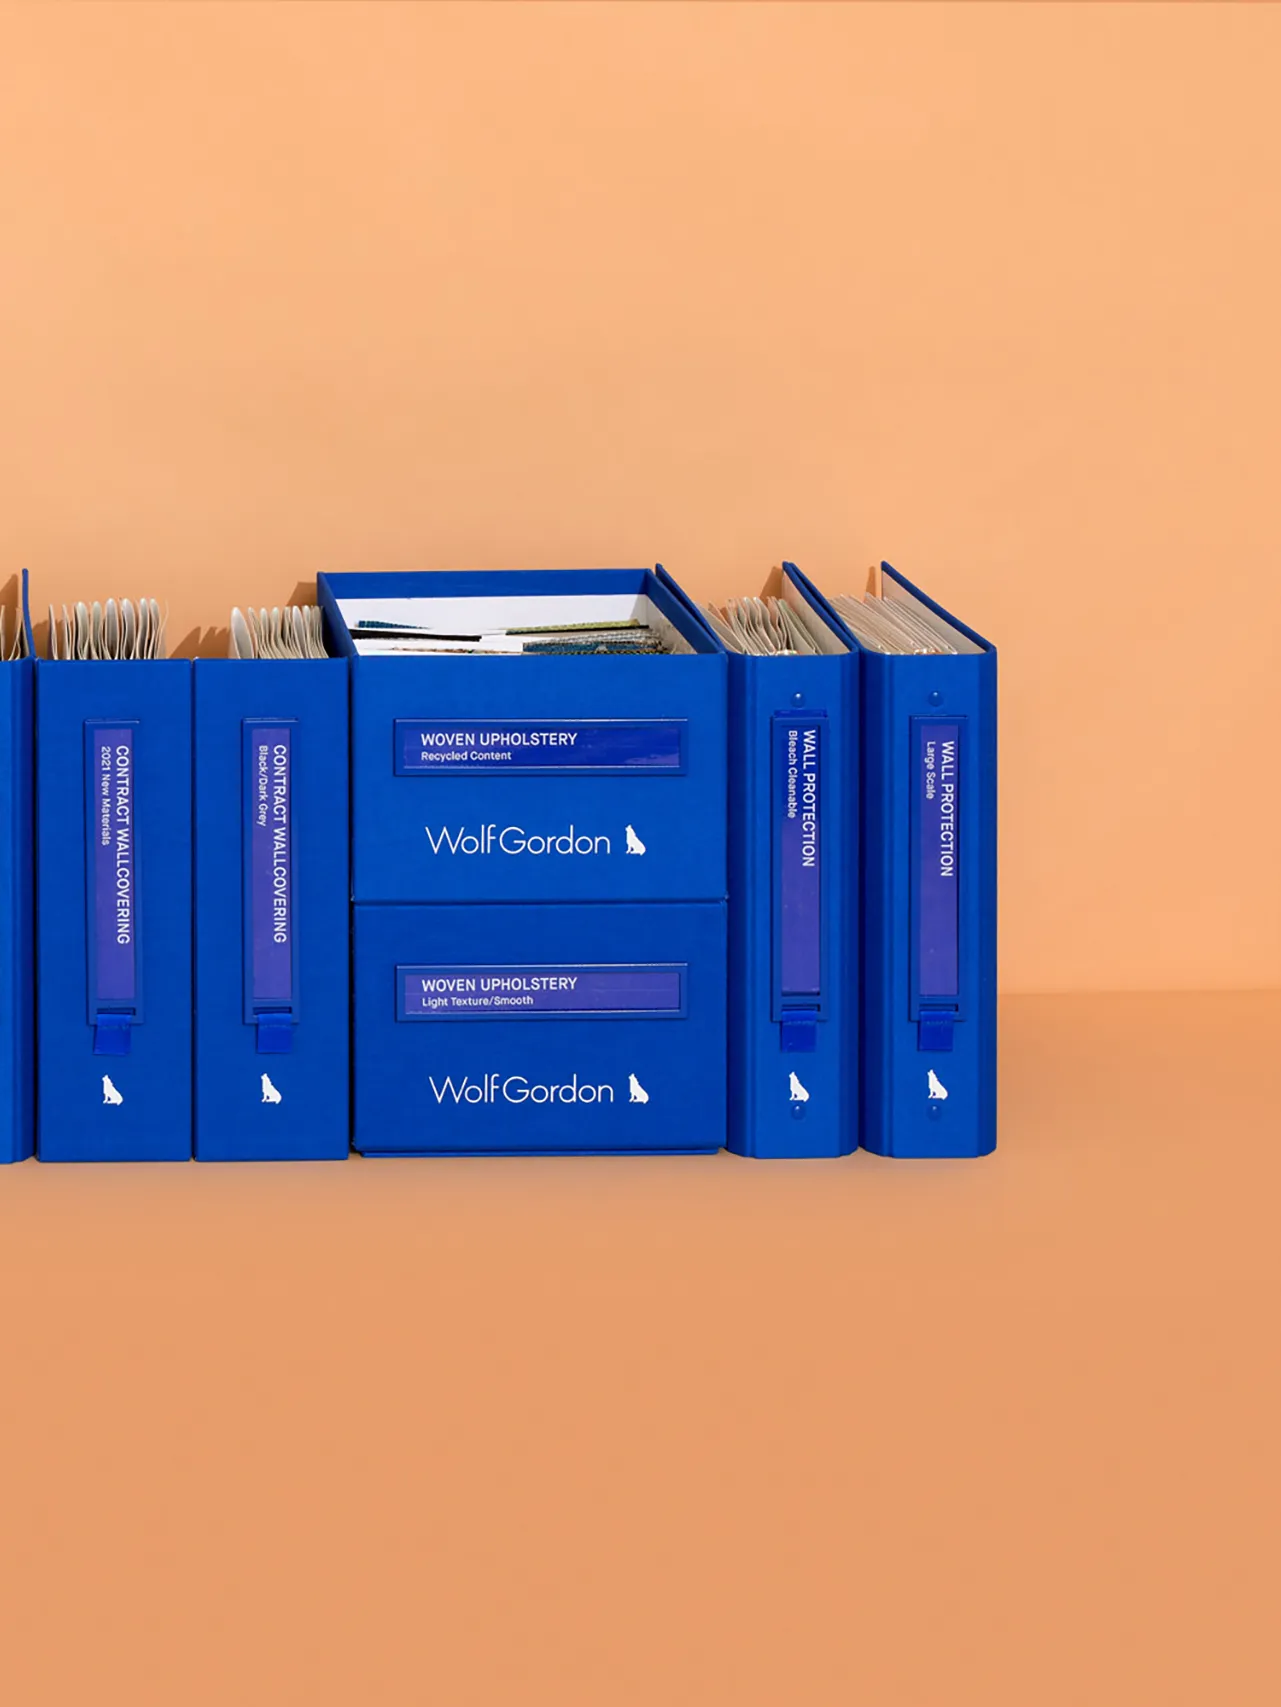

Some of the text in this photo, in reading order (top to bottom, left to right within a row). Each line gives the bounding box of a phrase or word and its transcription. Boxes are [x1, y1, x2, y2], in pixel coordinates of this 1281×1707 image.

[420, 732, 578, 747] WOVEN UPHOLSTERY
[420, 750, 512, 763] Recycled Content
[787, 730, 798, 819] Bleach Cleanable
[923, 741, 937, 800] Large Scale
[101, 746, 112, 846] 2021 New Materials
[256, 745, 269, 827] Black/Dark Grey
[801, 729, 816, 867] WALL PROTECTION
[940, 740, 955, 877] WALL PROTECTION
[115, 745, 131, 945] CONTRACT WALLCOVERING
[273, 744, 287, 943] CONTRACT WALLCOVERING
[421, 976, 578, 993] WOVEN UPHOLSTERY
[422, 995, 534, 1010] Light Texture/Smooth
